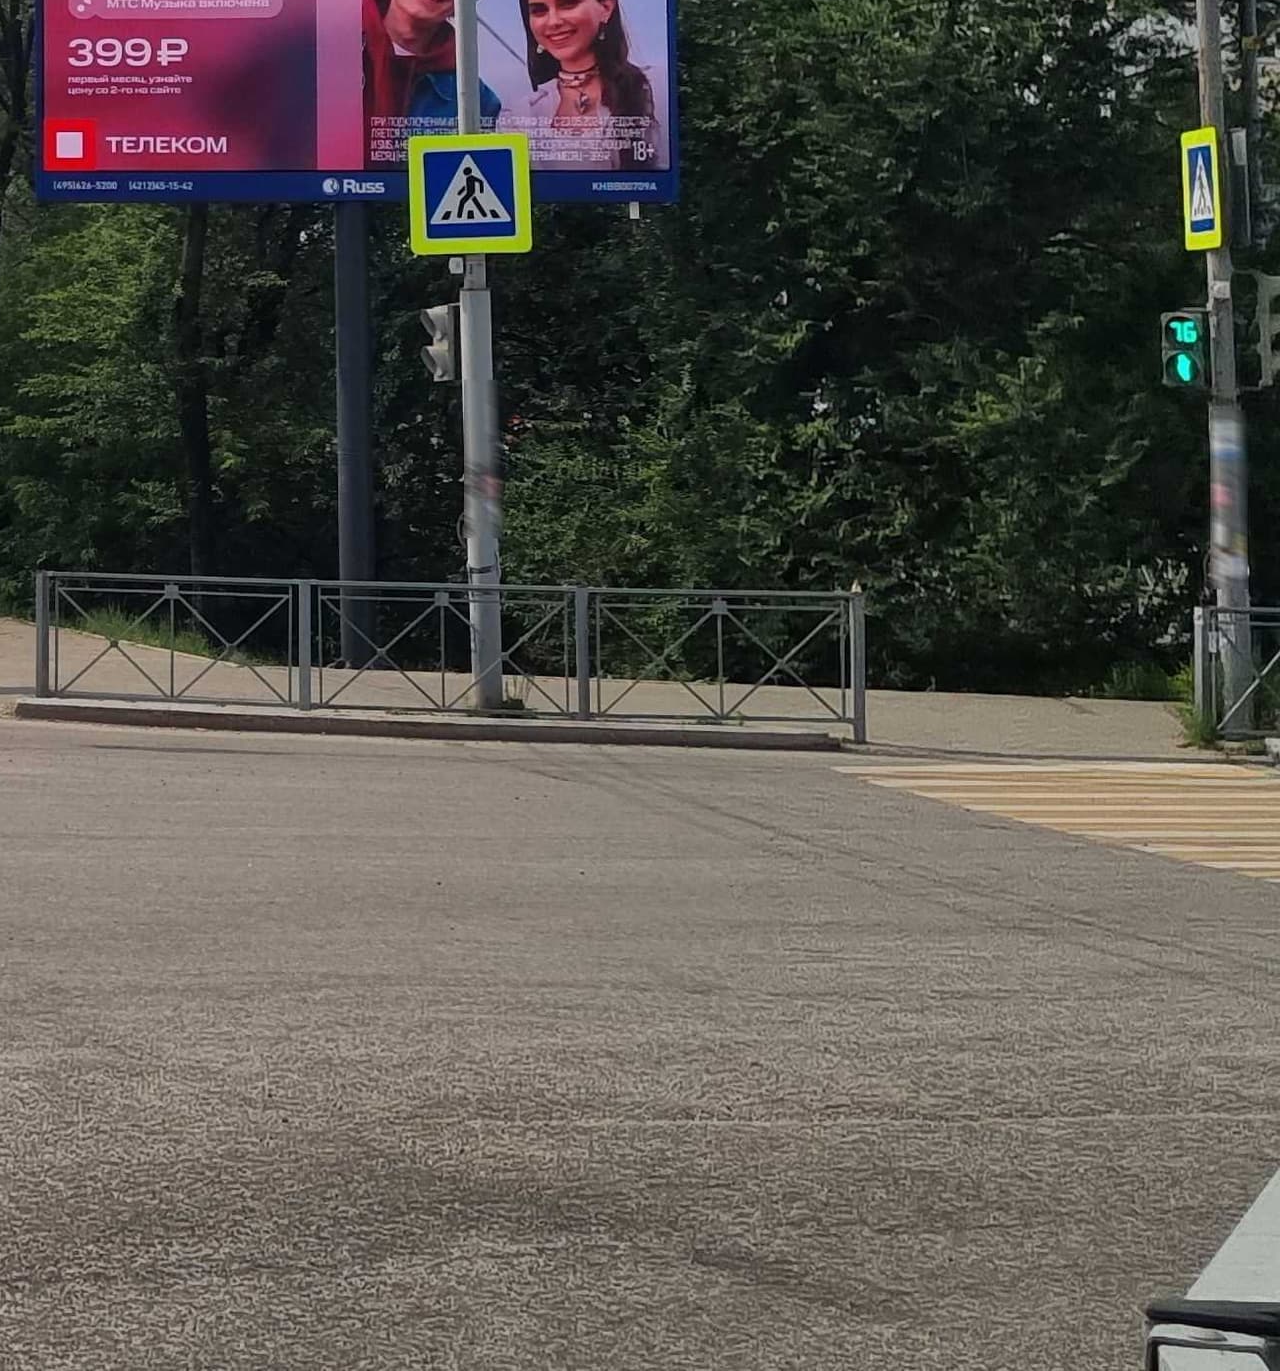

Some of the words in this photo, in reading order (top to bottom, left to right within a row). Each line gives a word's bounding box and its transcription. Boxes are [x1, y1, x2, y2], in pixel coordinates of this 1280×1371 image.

[149, 74, 193, 86] узнайте
[105, 136, 227, 153] ТЕЛЕКОМ
[632, 140, 655, 161] 18+
[343, 179, 385, 194] Russ
